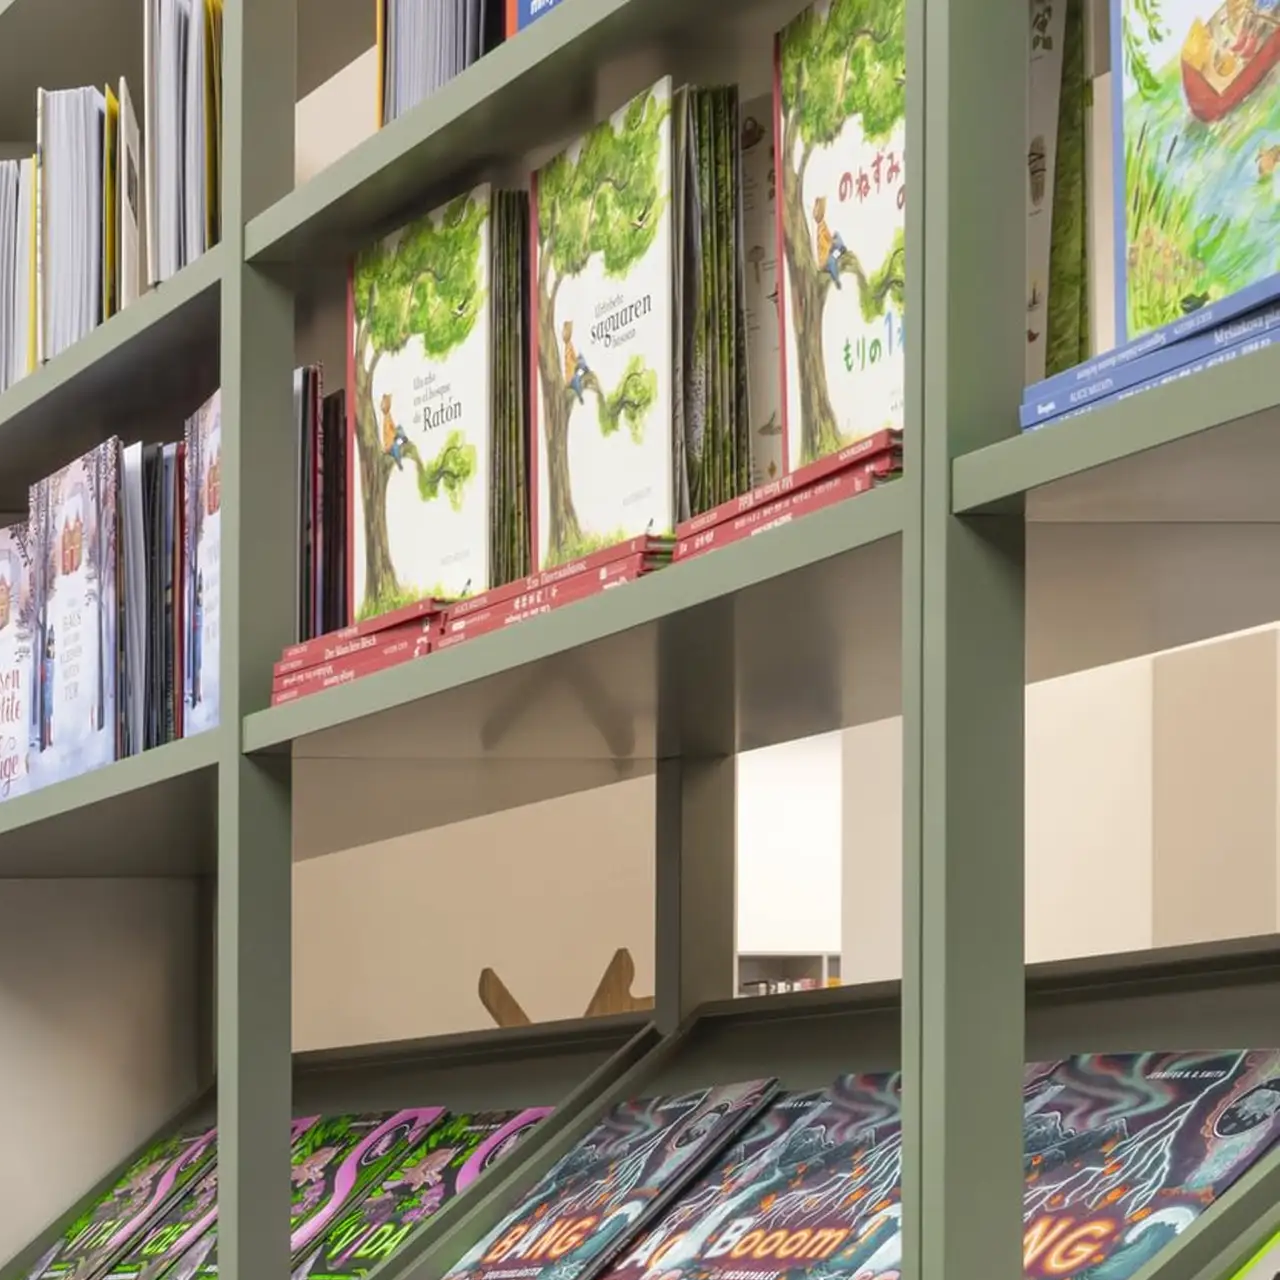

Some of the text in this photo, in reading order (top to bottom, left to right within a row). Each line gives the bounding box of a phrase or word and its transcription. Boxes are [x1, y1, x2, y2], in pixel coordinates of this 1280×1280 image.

[838, 146, 905, 205] のねずみ
[590, 294, 652, 348] saguaren
[422, 396, 462, 433] Ratón
[326, 1221, 413, 1267] VIDA
[482, 1214, 598, 1264] BANG
[1023, 1215, 1115, 1273] NG
